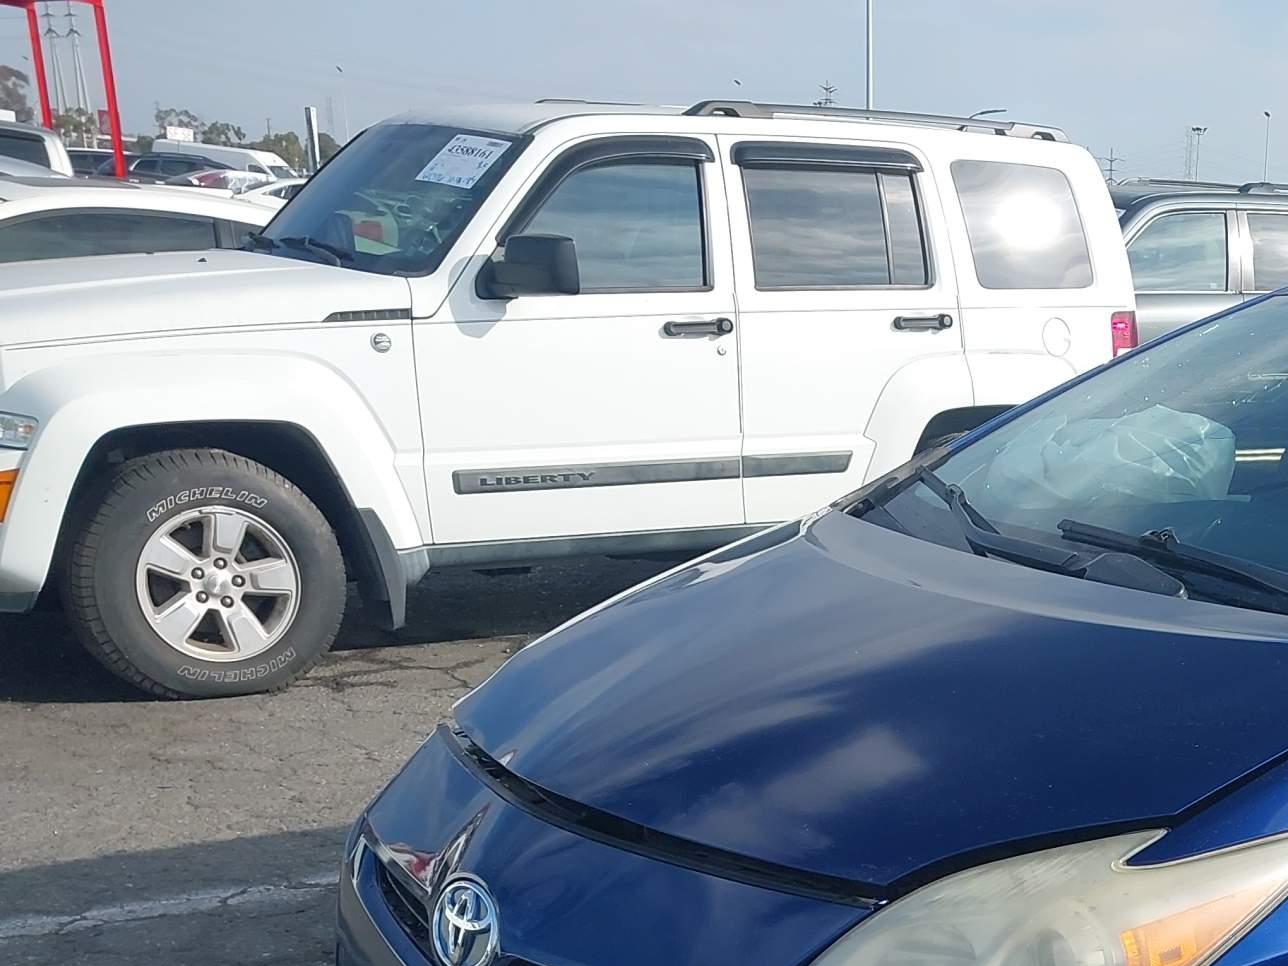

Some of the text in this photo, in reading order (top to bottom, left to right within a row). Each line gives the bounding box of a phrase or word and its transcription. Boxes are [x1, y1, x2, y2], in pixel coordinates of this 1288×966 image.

[479, 472, 595, 487] LIBERTY
[146, 486, 268, 522] MICHELIN
[177, 646, 297, 682] MICHELIN
